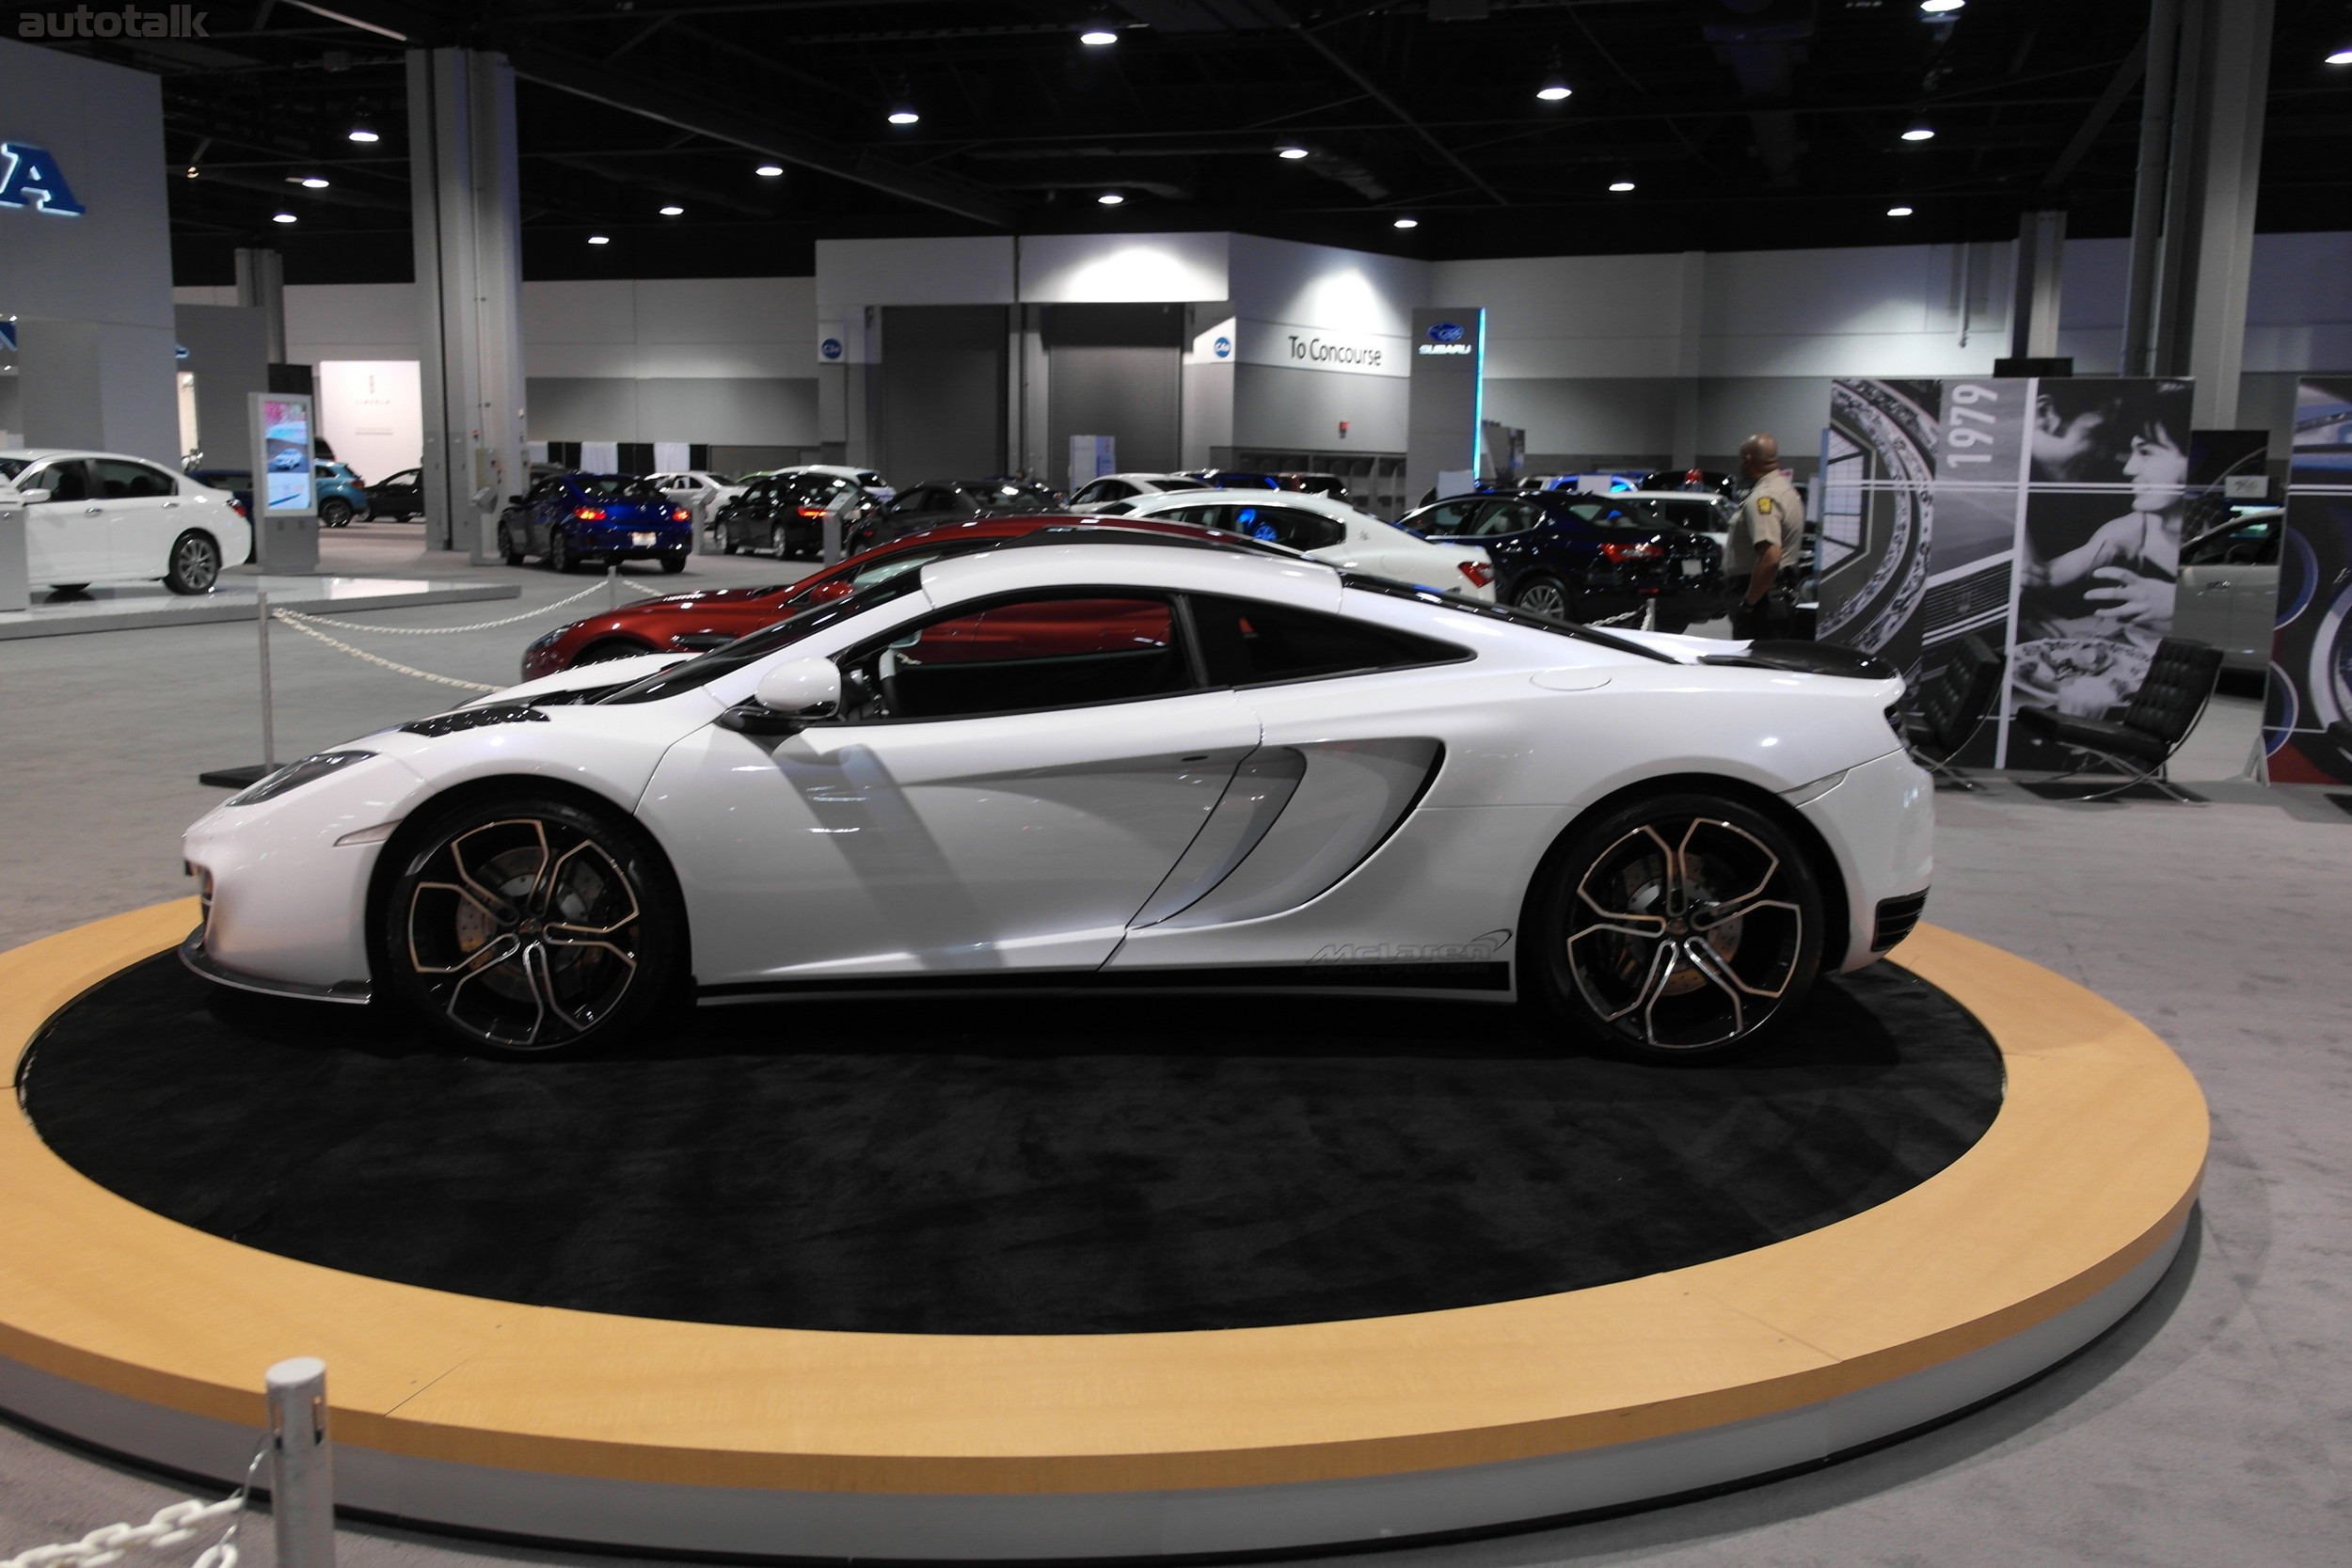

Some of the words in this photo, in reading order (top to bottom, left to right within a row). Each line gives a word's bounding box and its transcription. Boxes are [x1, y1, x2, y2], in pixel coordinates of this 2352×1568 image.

[1289, 336, 1306, 359] To
[1310, 339, 1382, 366] Concourse
[1419, 344, 1471, 355] SUBARU
[1947, 384, 1997, 467] 1979
[1305, 943, 1490, 964] McLaren
